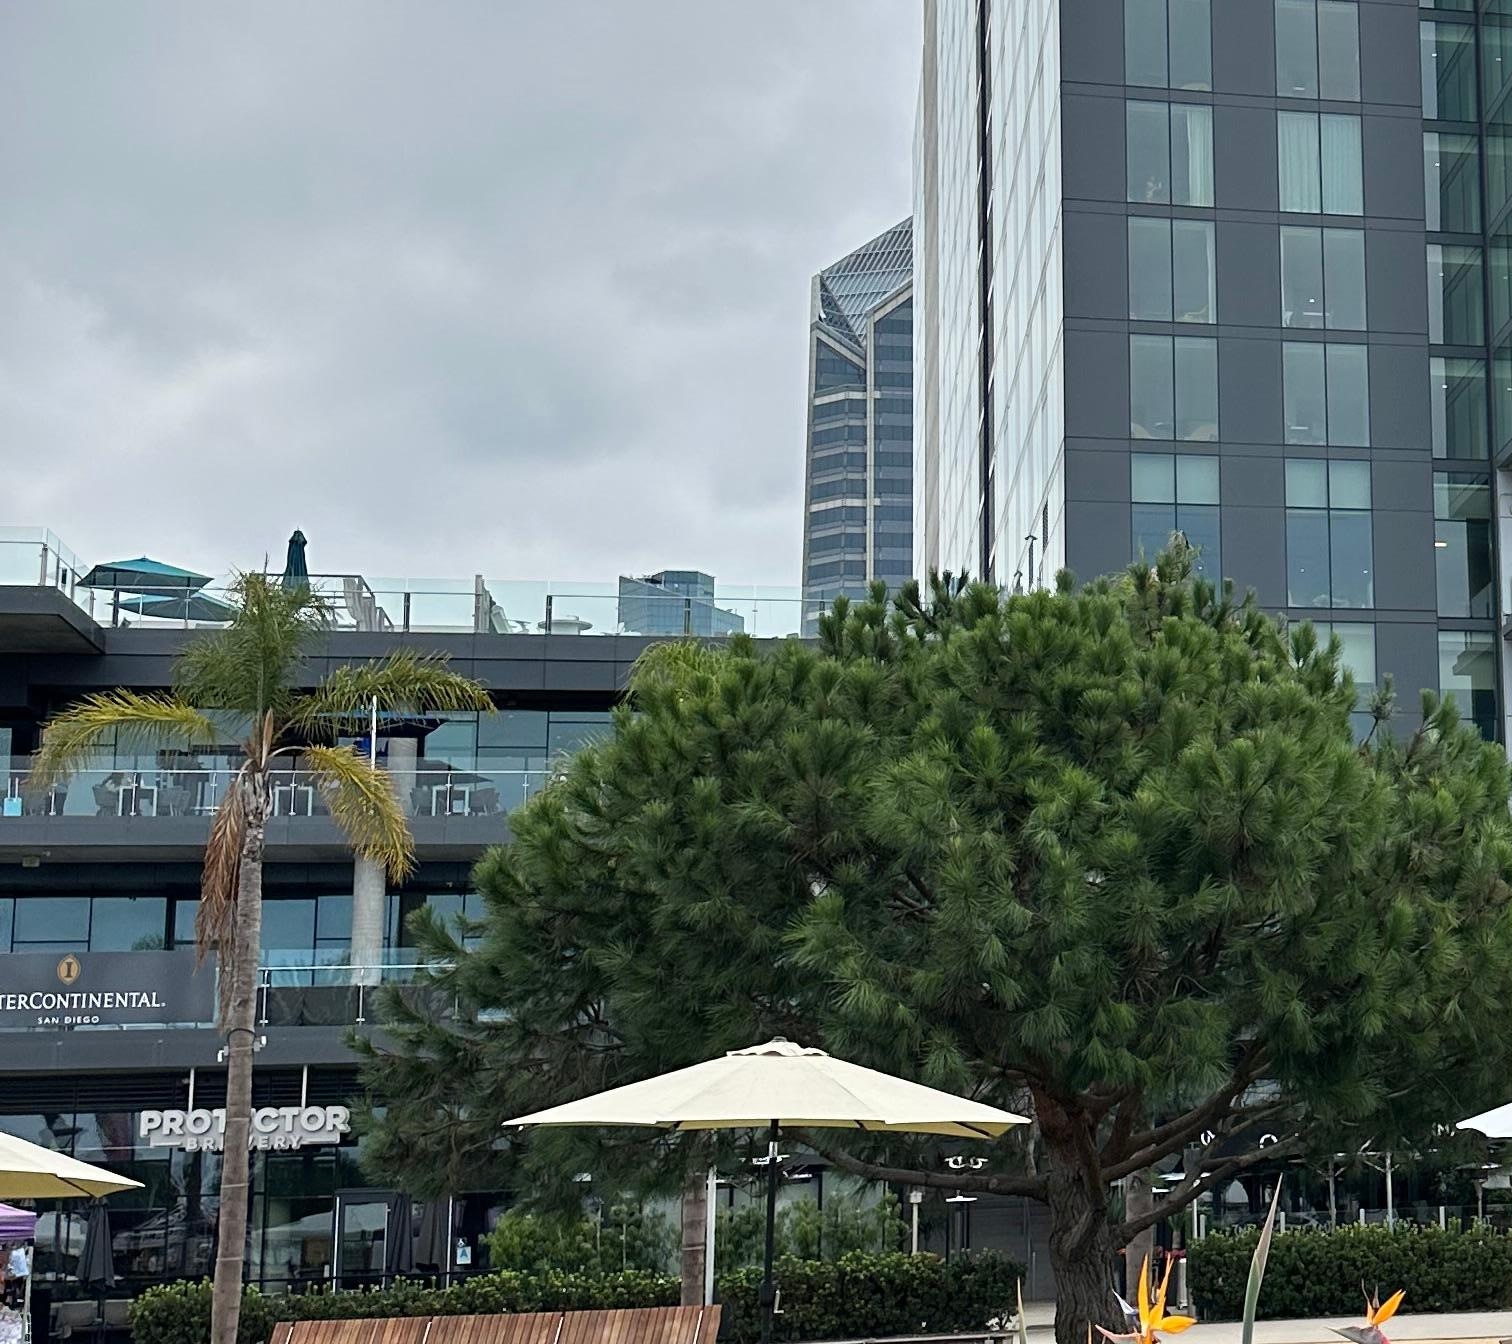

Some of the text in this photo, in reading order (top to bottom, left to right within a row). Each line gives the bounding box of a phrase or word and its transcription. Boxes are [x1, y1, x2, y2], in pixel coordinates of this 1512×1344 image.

[37, 1015, 100, 1025] SAN DIEGO
[140, 1106, 351, 1137] PROTCTOR
[186, 1134, 304, 1151] BRERY
